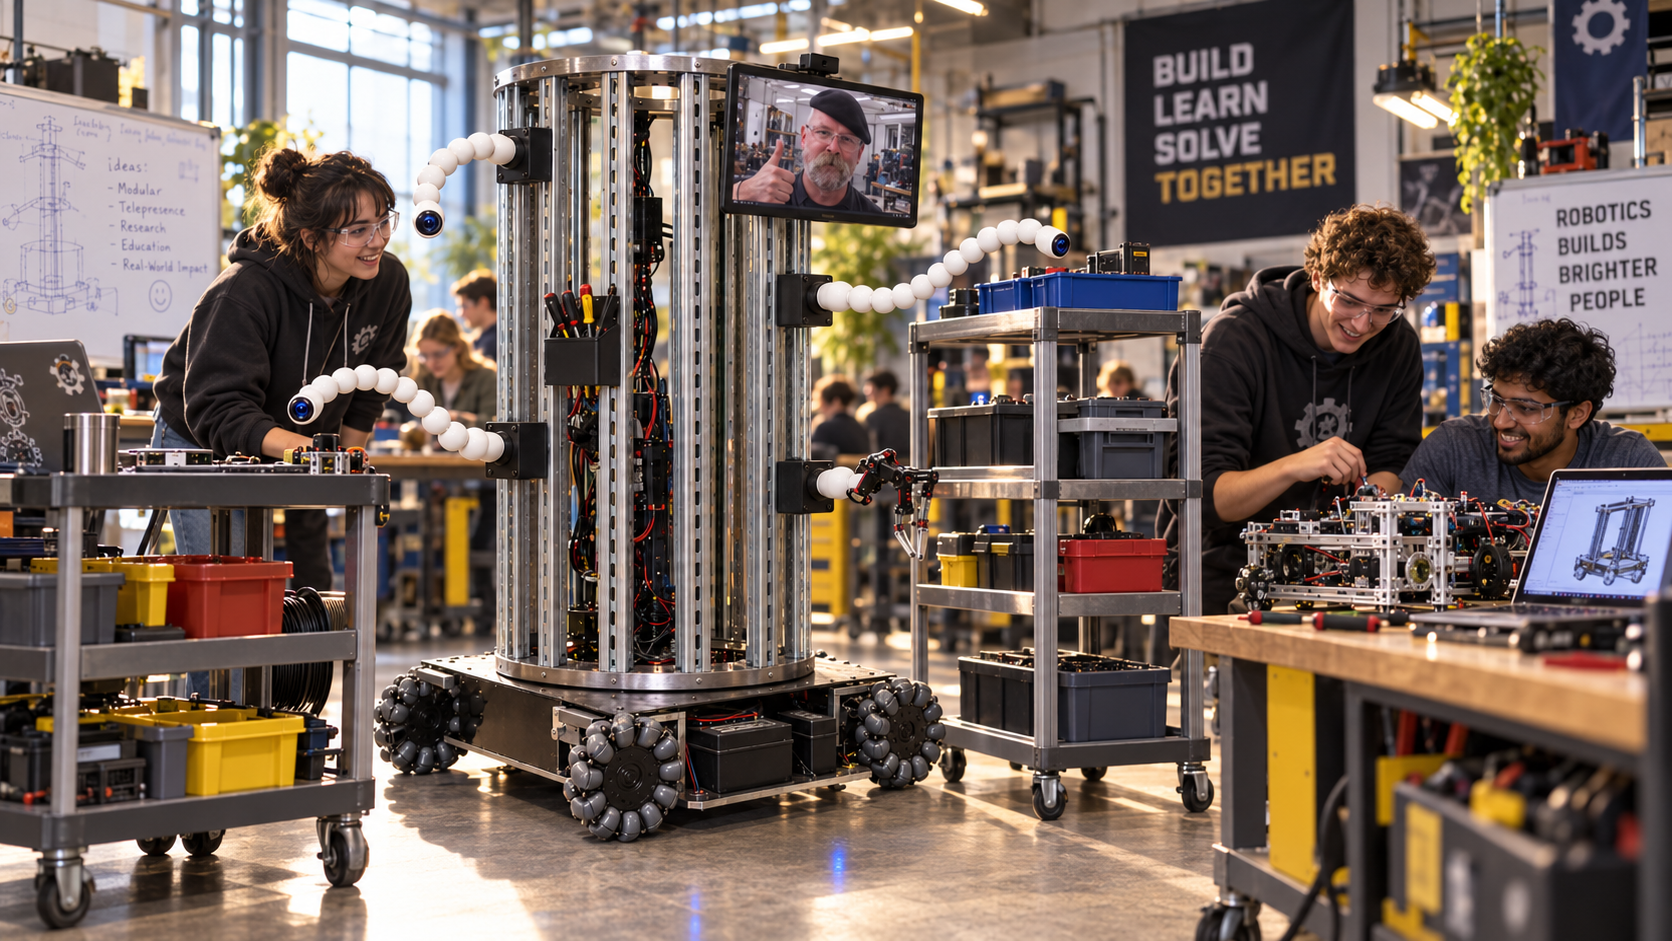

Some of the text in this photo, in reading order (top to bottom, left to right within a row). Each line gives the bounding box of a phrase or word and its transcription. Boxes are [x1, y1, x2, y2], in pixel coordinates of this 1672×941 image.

[1153, 42, 1254, 88] BUILD
[1154, 80, 1268, 127] LEARN
[1154, 121, 1262, 166] SOLVE
[108, 157, 148, 173] ideas:
[118, 182, 163, 196] Modular
[1154, 152, 1337, 204] TOGETHER
[118, 201, 186, 219] Telepresence
[1556, 200, 1652, 228] ROBOTICS
[120, 219, 167, 234] Research
[121, 238, 171, 252] Education
[1558, 231, 1627, 256] BUILDS
[123, 257, 208, 278] Real-World Impact
[1559, 257, 1658, 284] BRIGHTER
[1570, 288, 1646, 312] PEOPLE
